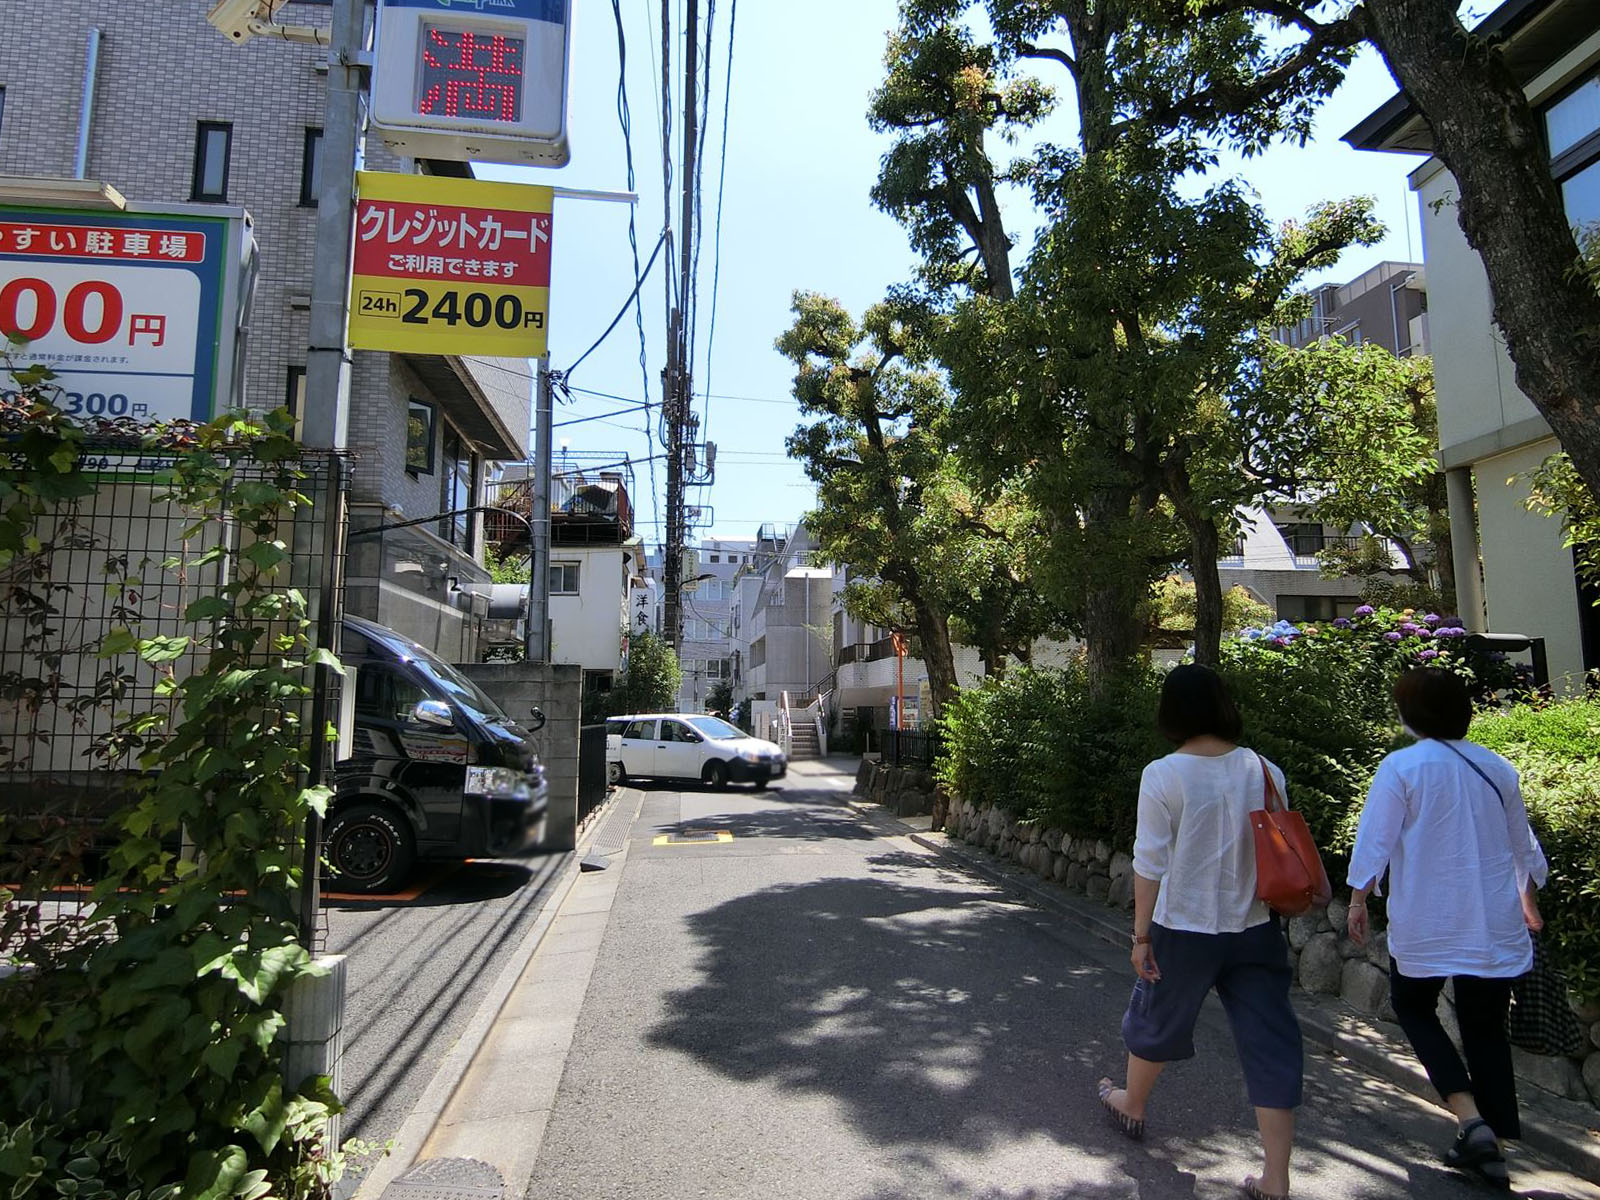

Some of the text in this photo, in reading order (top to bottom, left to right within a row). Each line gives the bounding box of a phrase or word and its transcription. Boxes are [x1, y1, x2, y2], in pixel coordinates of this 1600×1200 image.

[421, 28, 522, 122] 満
[0, 227, 188, 258] すい駐車場
[361, 205, 549, 253] クレジットカード
[388, 253, 519, 278] ご利用できます
[362, 288, 544, 329] 24h 2400円
[635, 594, 649, 625] 洋食
